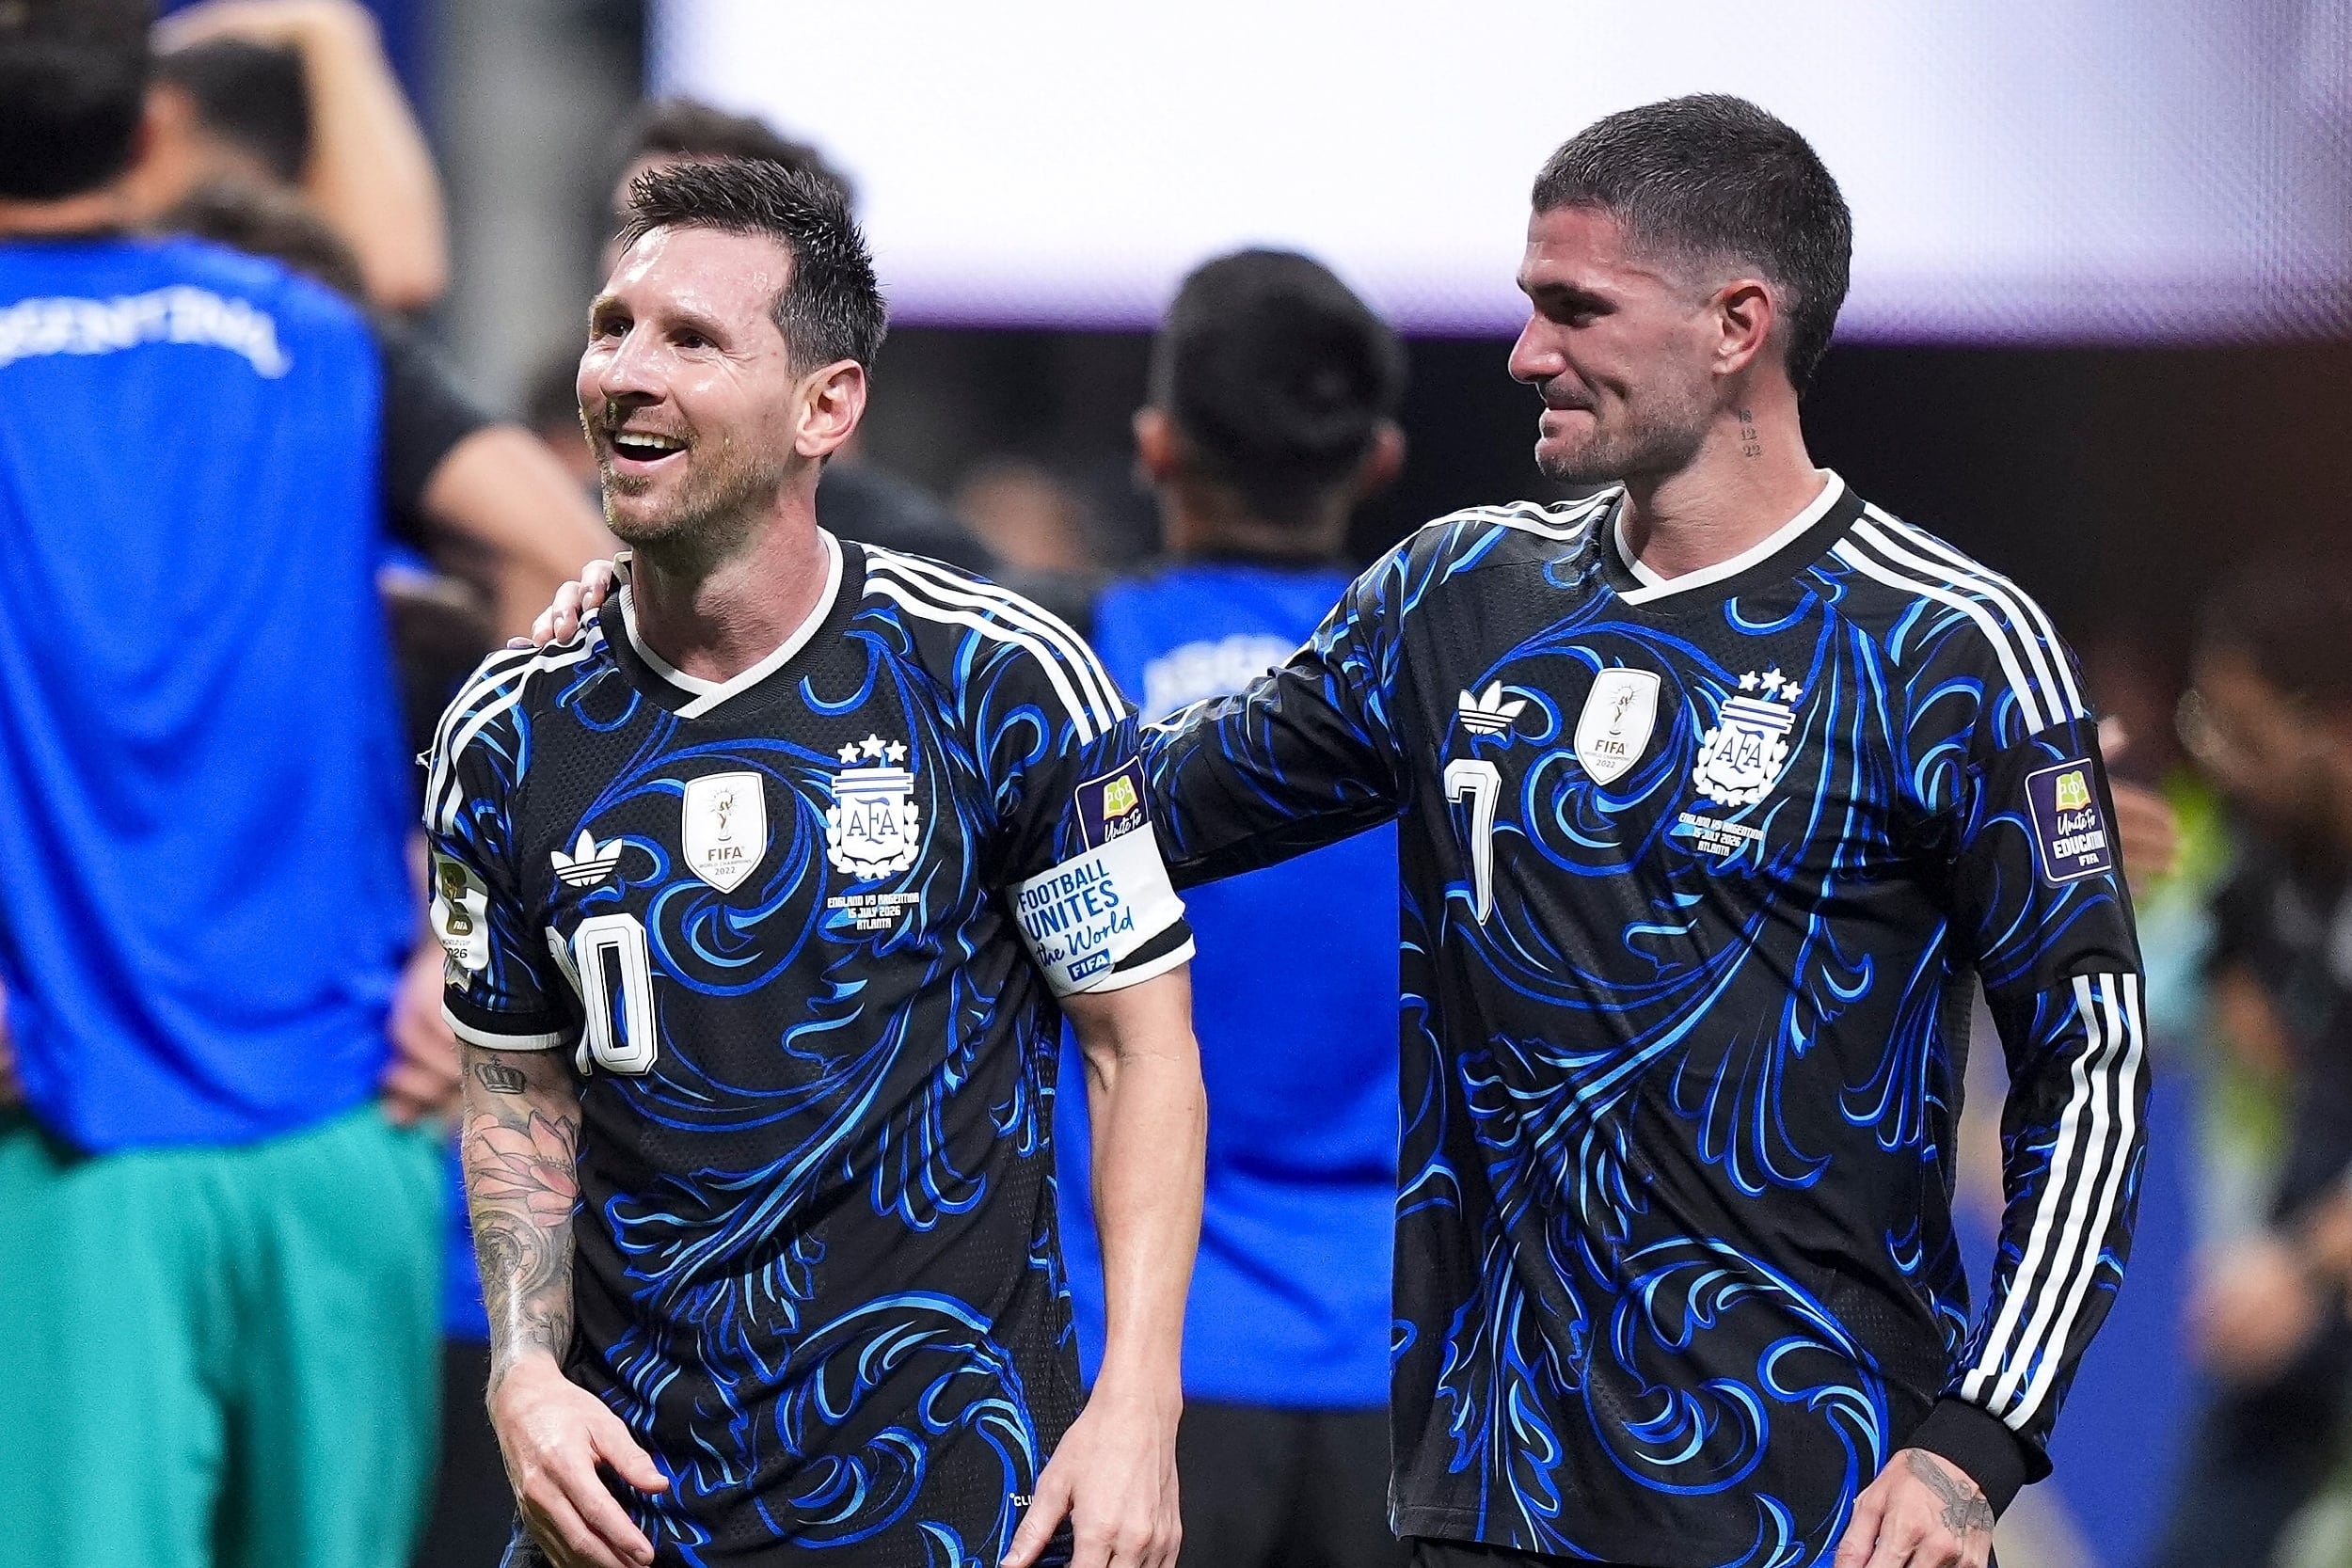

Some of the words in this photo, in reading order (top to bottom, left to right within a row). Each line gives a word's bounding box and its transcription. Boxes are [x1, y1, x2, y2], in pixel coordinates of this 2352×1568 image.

[1742, 444, 1761, 457] 22
[1595, 739, 1625, 755] FIFA
[1716, 725, 1765, 774] AFA
[1596, 759, 1616, 768] 2022
[847, 797, 898, 845] AFA
[1444, 758, 1502, 926] 7
[1697, 840, 1730, 856] ATLANTA
[1720, 833, 1741, 847] 2026
[708, 847, 742, 861] FIFA
[715, 866, 736, 876] 2022
[1018, 859, 1110, 912] FOOTBALL
[828, 895, 864, 909] ENGLAND
[865, 895, 877, 906] VS
[877, 892, 920, 905] ARGENTINA
[857, 906, 877, 918] JULY
[879, 906, 901, 917] 2026
[1024, 879, 1120, 941] UNITES
[856, 917, 892, 930] ATLANTA
[1037, 941, 1065, 967] the
[1065, 906, 1135, 956] World
[1071, 952, 1110, 979] FIFA
[545, 912, 658, 1076] 10
